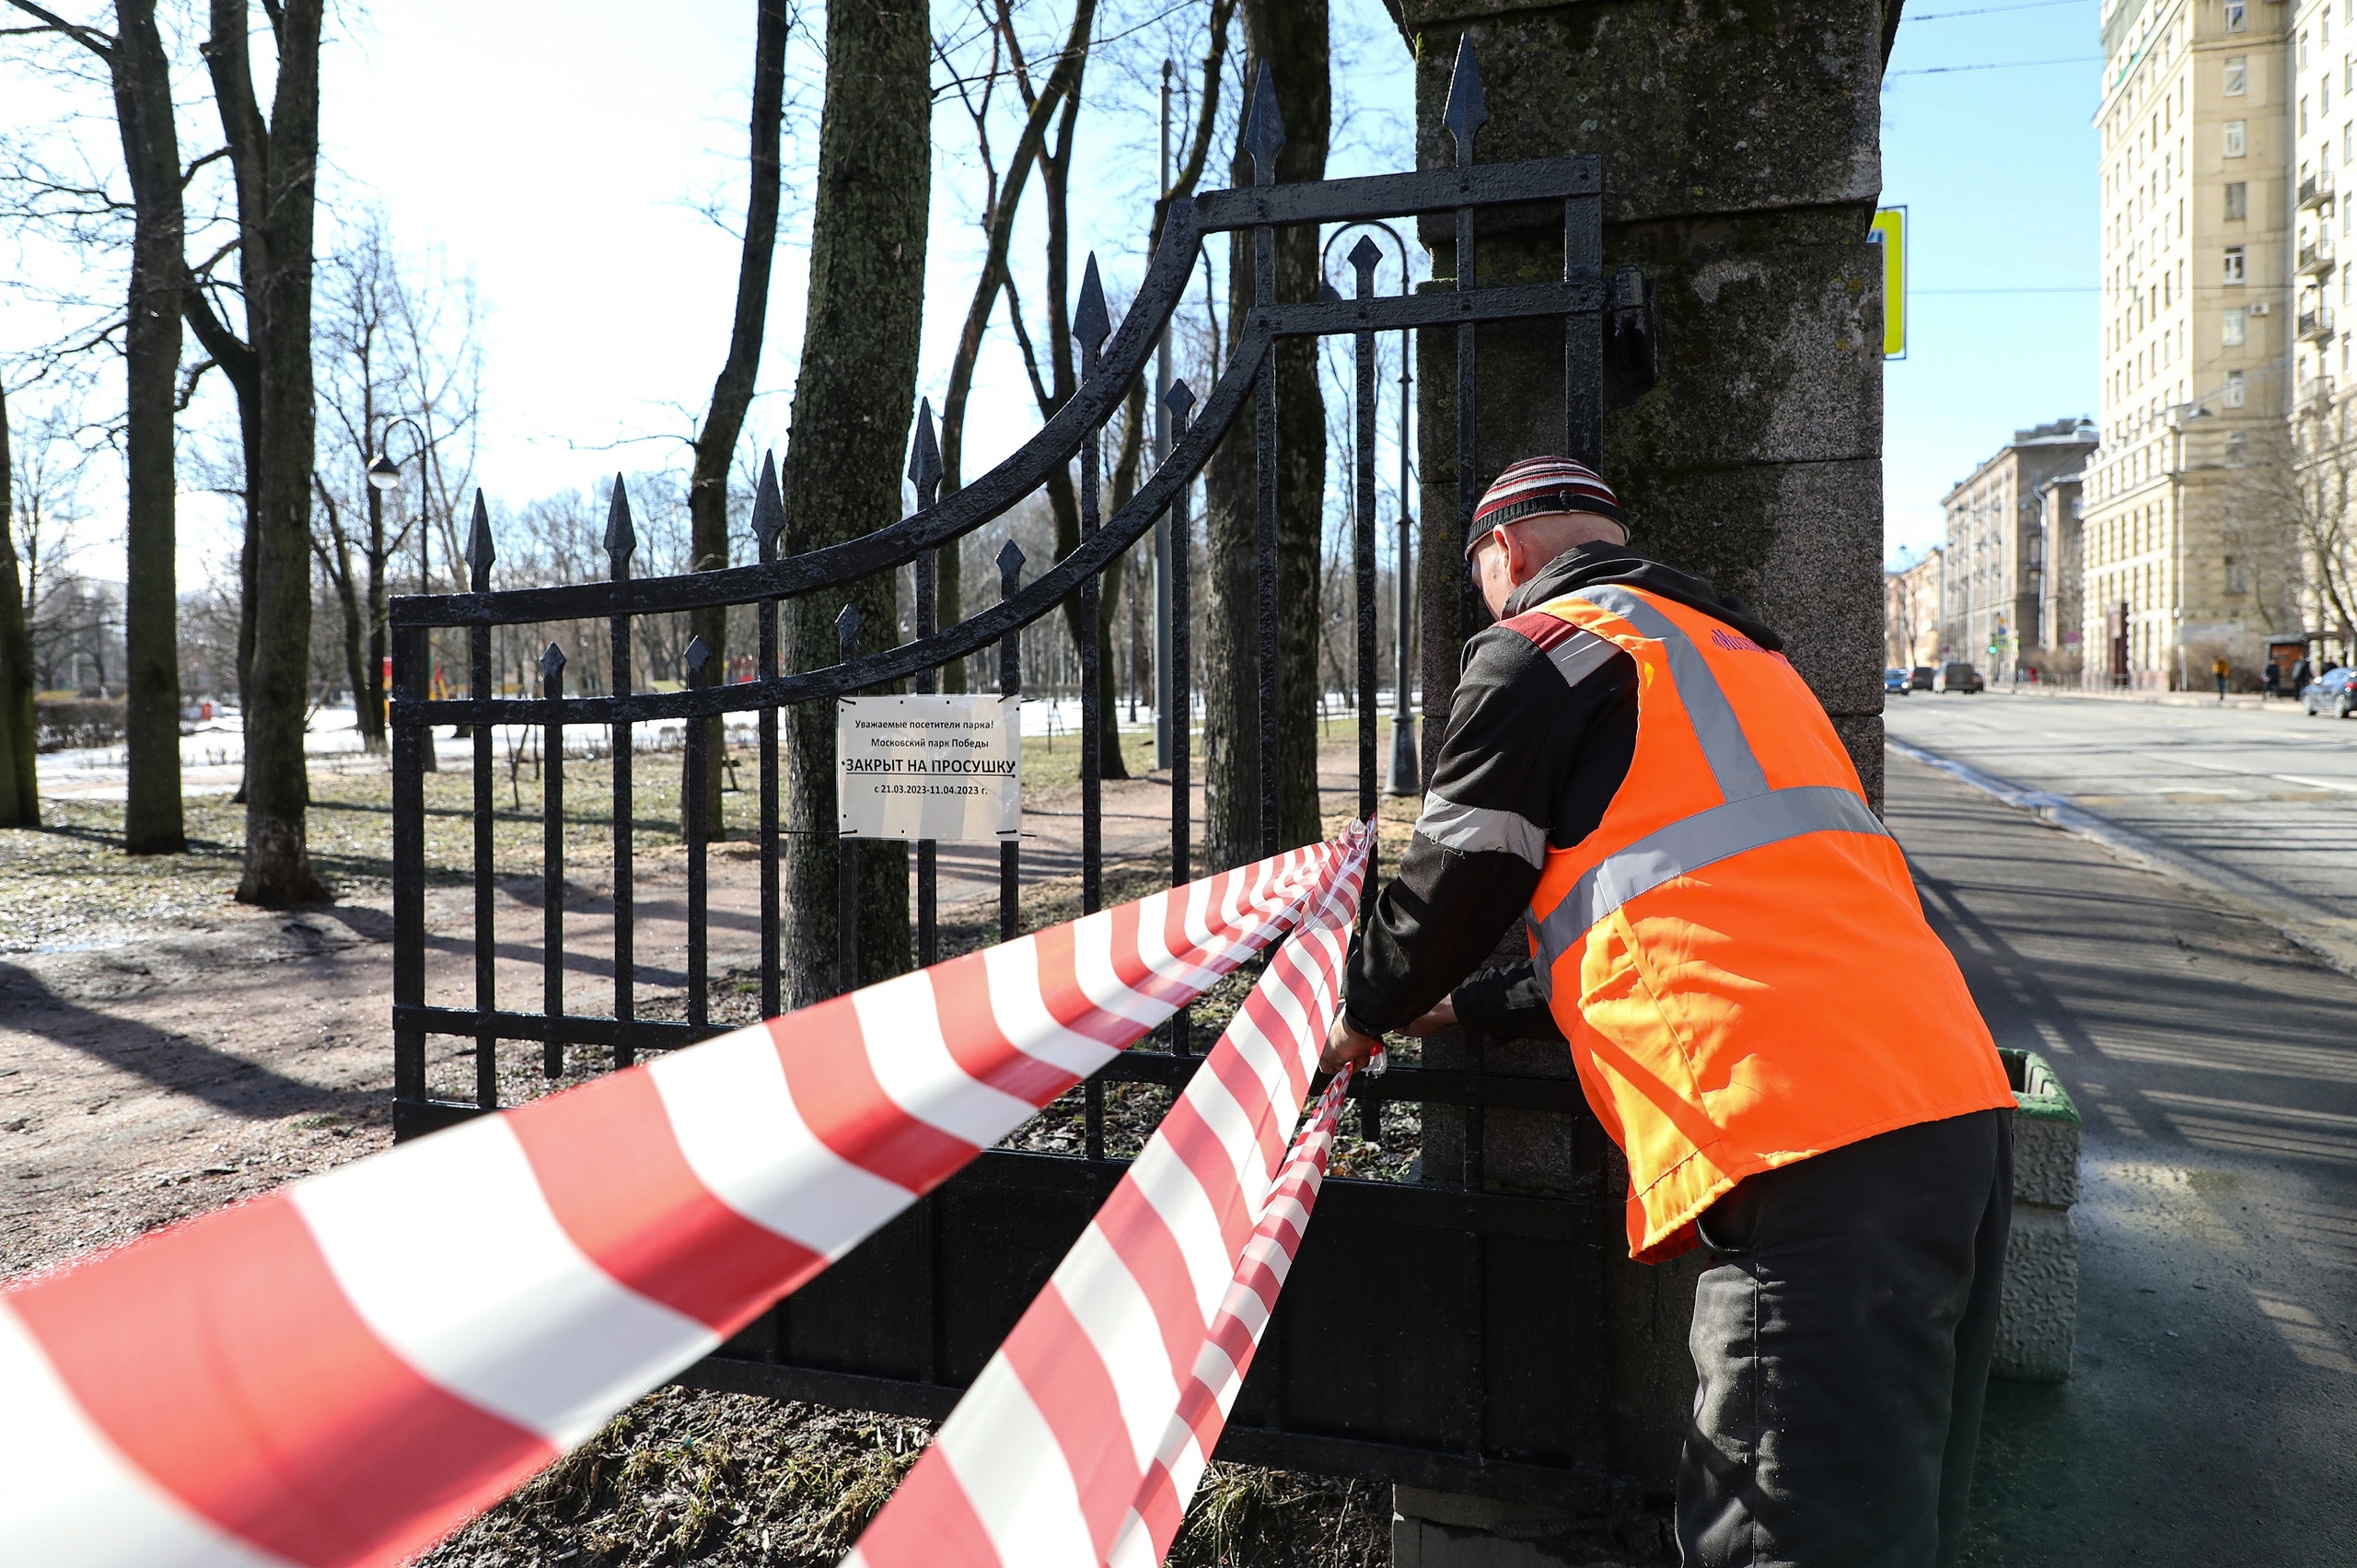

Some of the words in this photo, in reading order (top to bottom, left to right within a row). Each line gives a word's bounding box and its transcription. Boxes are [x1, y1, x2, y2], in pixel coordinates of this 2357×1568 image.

[854, 719, 908, 729] Уважаемые
[909, 721, 960, 730] посетители
[962, 720, 994, 730] парка!
[871, 738, 926, 748] Московский
[928, 740, 949, 749] парк
[951, 738, 989, 749] Победы
[846, 758, 904, 772] ЗАКРЫТ
[907, 759, 928, 772] НА
[931, 759, 1016, 773] ПРОСУШКУ
[874, 785, 879, 794] с
[880, 784, 979, 796] 21.03.2023-11.04.2023
[981, 787, 988, 796] г.
